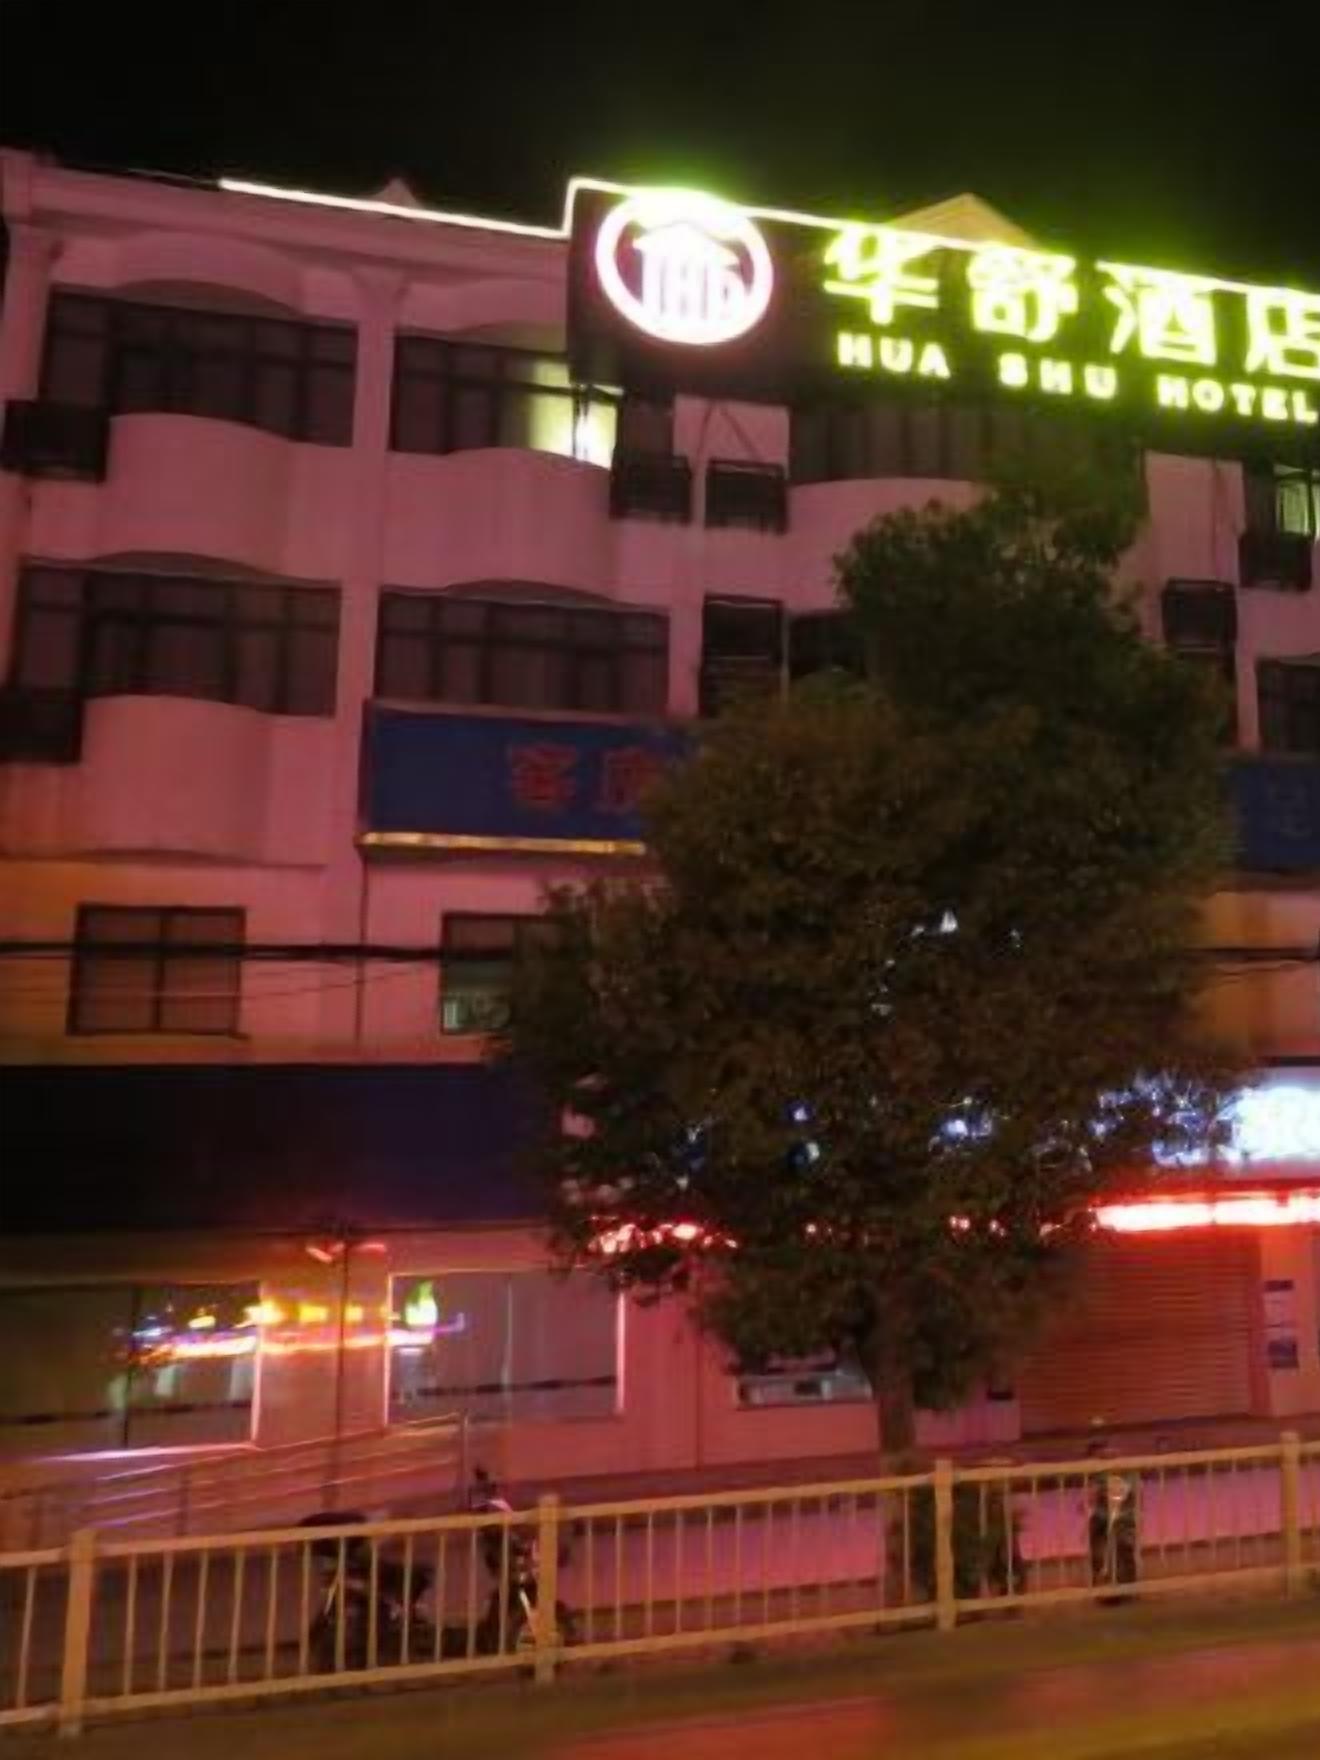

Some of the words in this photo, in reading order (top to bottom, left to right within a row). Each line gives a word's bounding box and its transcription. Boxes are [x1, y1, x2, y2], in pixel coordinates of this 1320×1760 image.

[837, 331, 951, 380] HUA
[998, 351, 1117, 400] SHU
[1156, 373, 1319, 425] HOTEL
